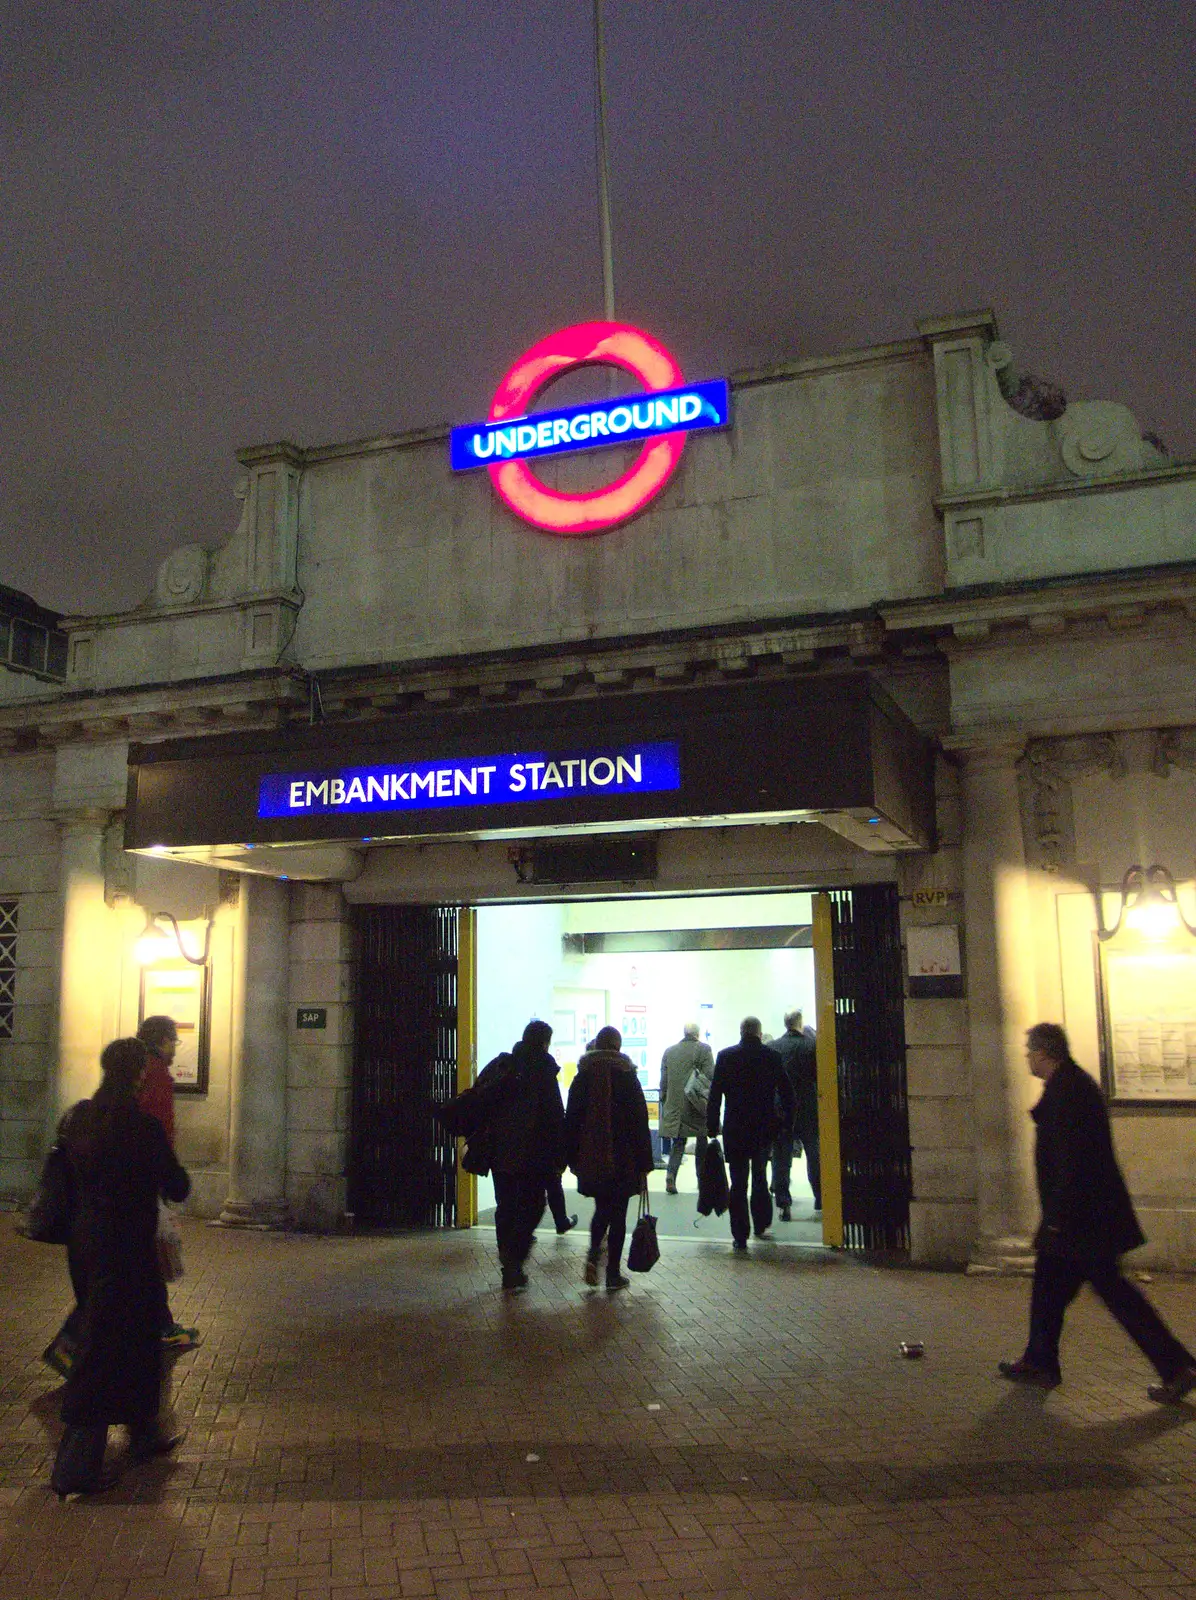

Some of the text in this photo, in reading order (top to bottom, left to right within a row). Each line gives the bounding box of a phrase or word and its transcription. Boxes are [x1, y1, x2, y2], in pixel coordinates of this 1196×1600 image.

[473, 395, 702, 458] UNDERGROUND
[289, 754, 642, 808] EMBANKMENT STATION
[915, 892, 945, 904] RVP
[302, 1013, 319, 1022] SAP
